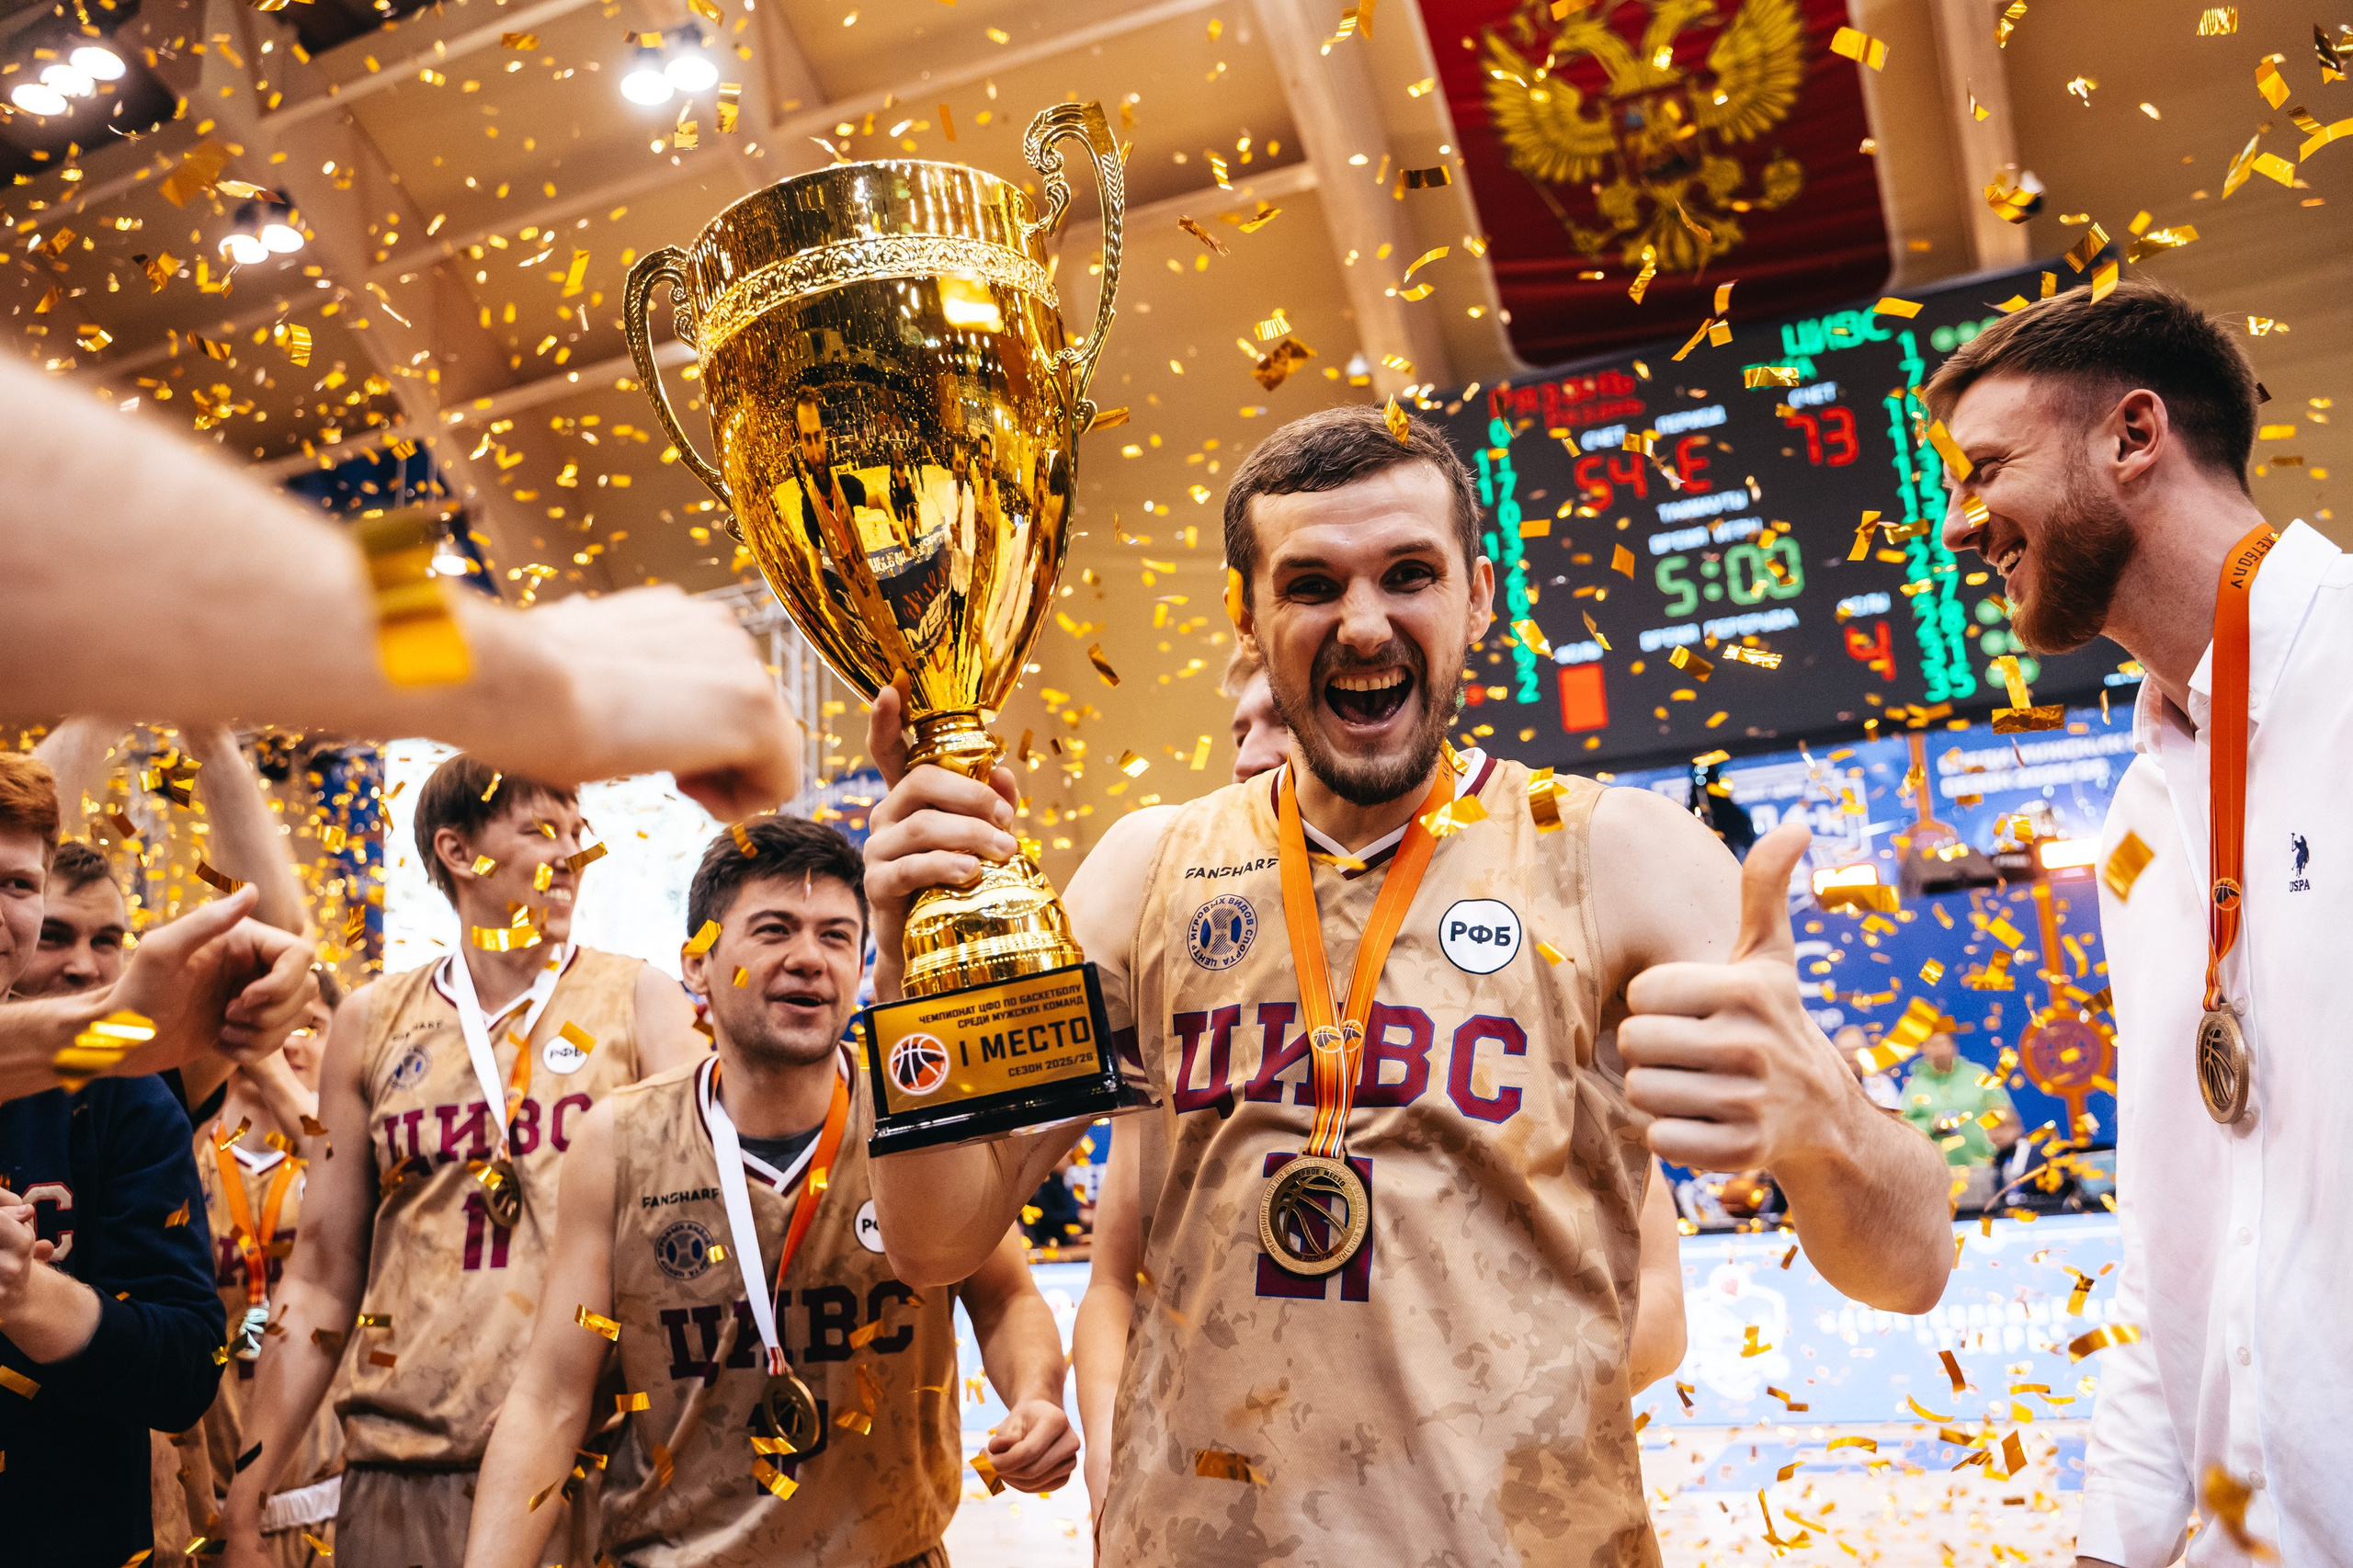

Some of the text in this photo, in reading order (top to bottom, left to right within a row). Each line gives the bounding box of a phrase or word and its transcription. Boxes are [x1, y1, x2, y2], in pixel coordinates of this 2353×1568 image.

[1785, 406, 1859, 466] 73
[1574, 451, 1648, 512] 54
[1655, 537, 1805, 618] 5:00
[1844, 621, 1897, 682] 4
[1185, 858, 1279, 879] FANSHARF
[2290, 879, 2311, 892] USPA
[1190, 897, 1254, 967] ЦЕНТР ИГРОВЫХ ВИДОВ СПОРТА
[1449, 920, 1512, 948] РФБ
[918, 983, 1082, 1025] ЧЕМПИОНАТ ЦФО ПО БАСКЕТБОЛУ
[958, 995, 1085, 1028] СРЕДИ МУЖСКИХ КОМАНД
[980, 1016, 1092, 1062] МЕСТО
[1007, 1051, 1094, 1077] СЕЗОН 2025/26
[1173, 1001, 1528, 1124] ЦИВС
[384, 1092, 594, 1176] ЦИВС
[1324, 1170, 1347, 1187] МЕСТО
[659, 1278, 915, 1388] ЦИВС
